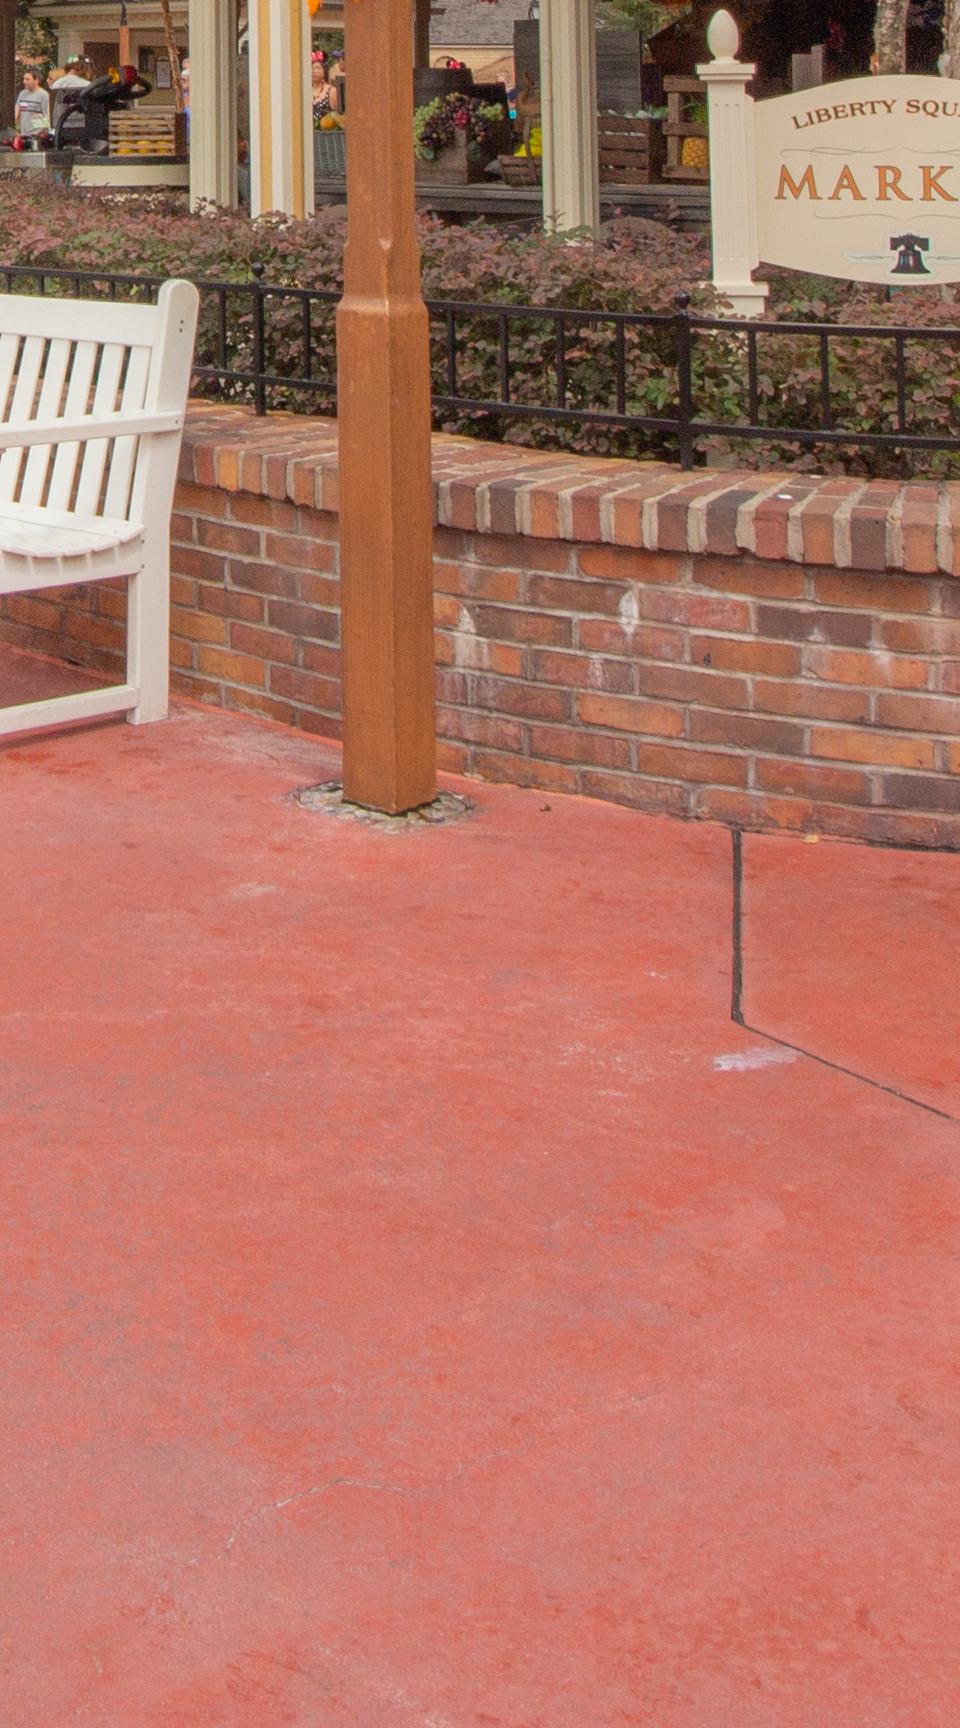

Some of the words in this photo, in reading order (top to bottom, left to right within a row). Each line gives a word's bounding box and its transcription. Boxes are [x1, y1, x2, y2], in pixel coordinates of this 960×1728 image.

[792, 99, 897, 130] LIBERTY
[906, 98, 960, 118] SQU
[774, 163, 960, 202] MARK
